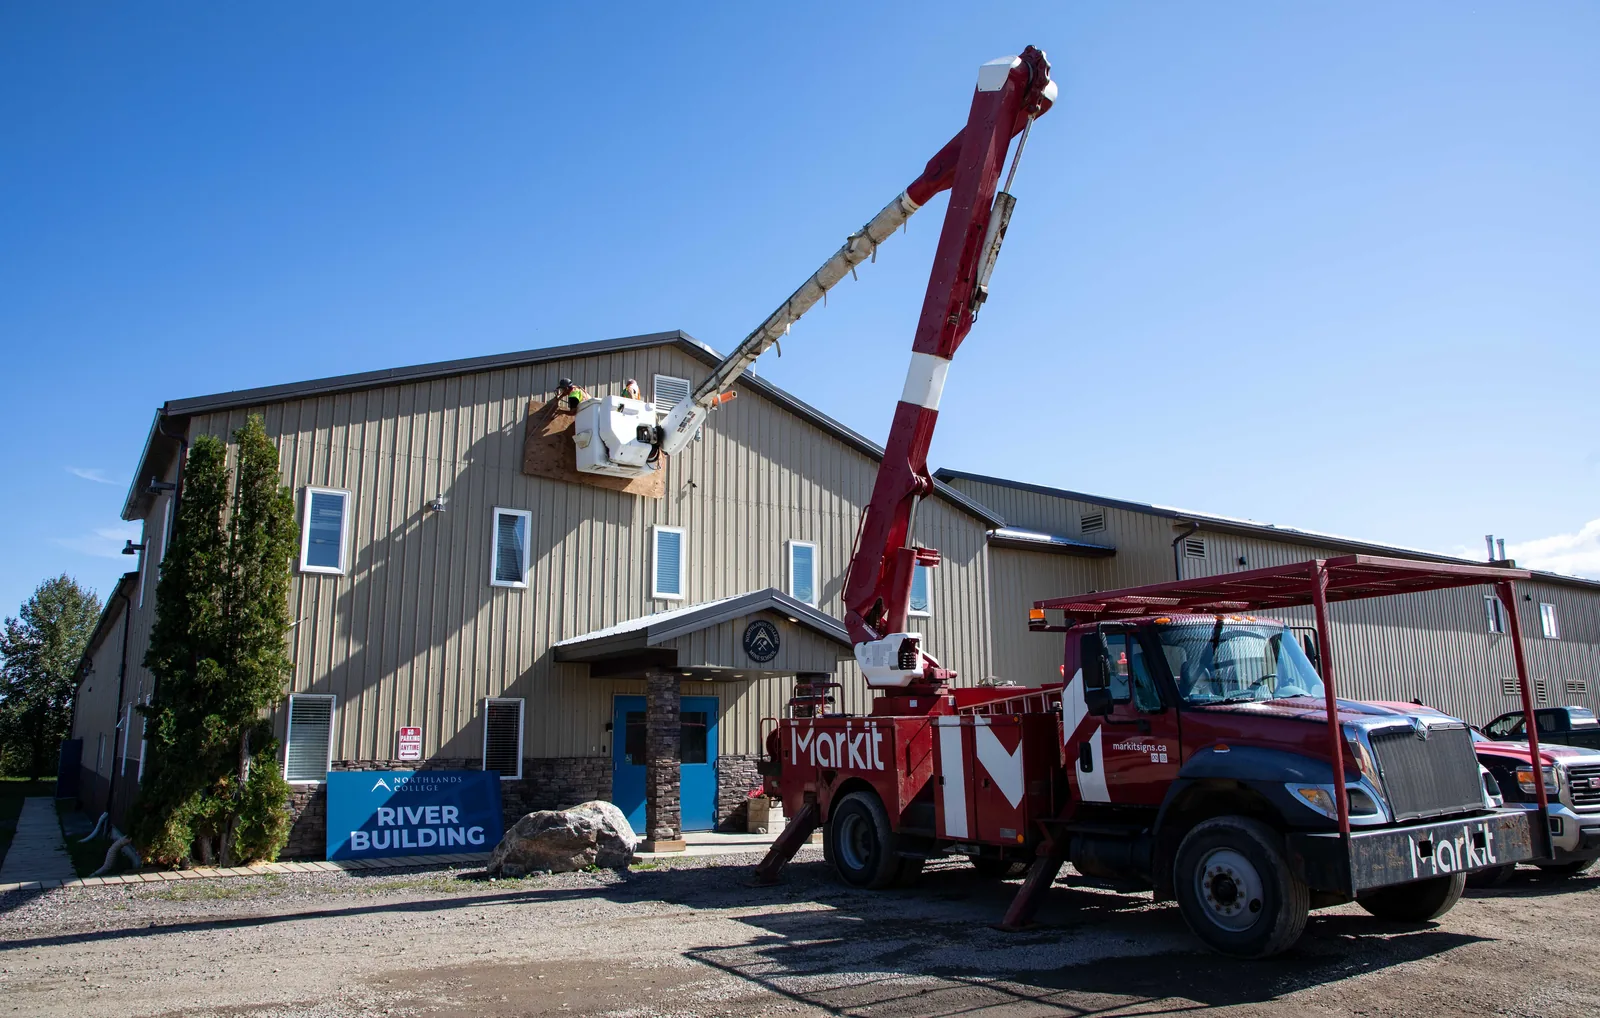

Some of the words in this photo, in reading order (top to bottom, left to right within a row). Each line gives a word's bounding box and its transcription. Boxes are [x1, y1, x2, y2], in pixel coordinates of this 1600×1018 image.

[790, 719, 885, 771] Markit
[1112, 742, 1167, 754] markitsigns.ca
[393, 776, 462, 784] NORTHLANDS
[377, 805, 460, 827] RIVER
[351, 826, 485, 851] BUILDING
[1408, 823, 1497, 879] Markit
